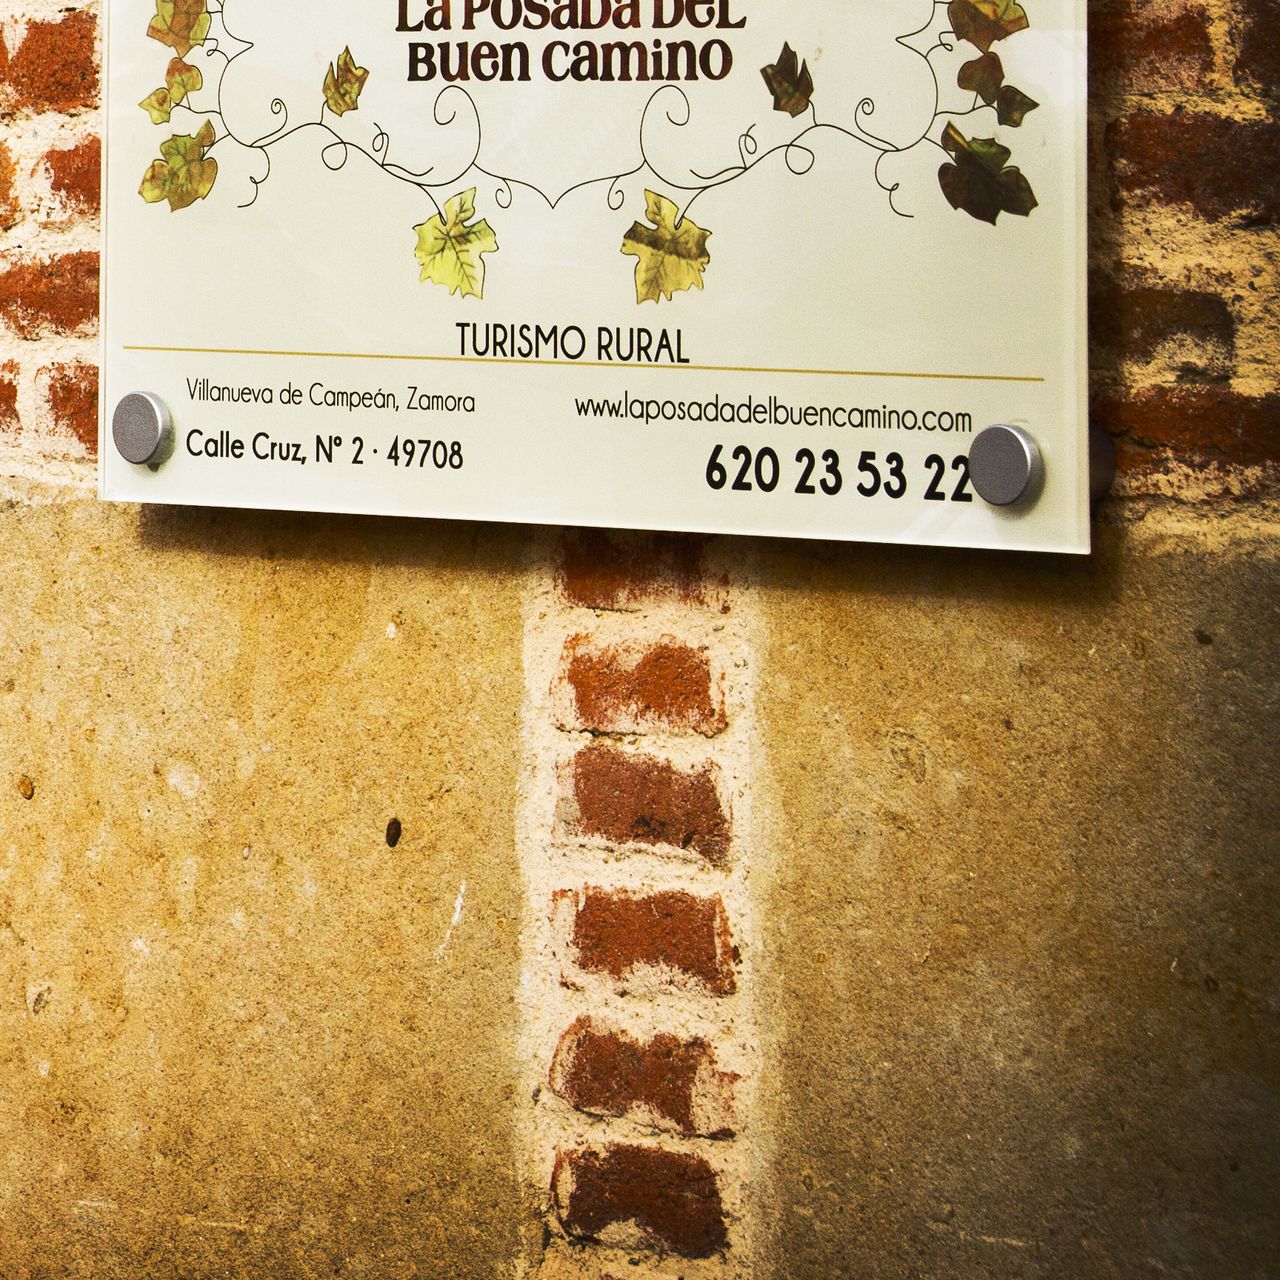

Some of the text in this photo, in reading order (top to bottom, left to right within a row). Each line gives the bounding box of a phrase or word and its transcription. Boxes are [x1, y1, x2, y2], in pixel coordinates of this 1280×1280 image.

[456, 323, 689, 363] TURISMO RURAL
[187, 377, 474, 412] Villanueva de Campeán, Zamora
[575, 390, 971, 432] www.laposadadelbuencamino.com
[187, 429, 244, 458] Calle
[253, 432, 306, 464] Cruz,
[352, 437, 364, 464] 2
[387, 436, 463, 469] 49708
[706, 445, 973, 502] 620 23 53 22
